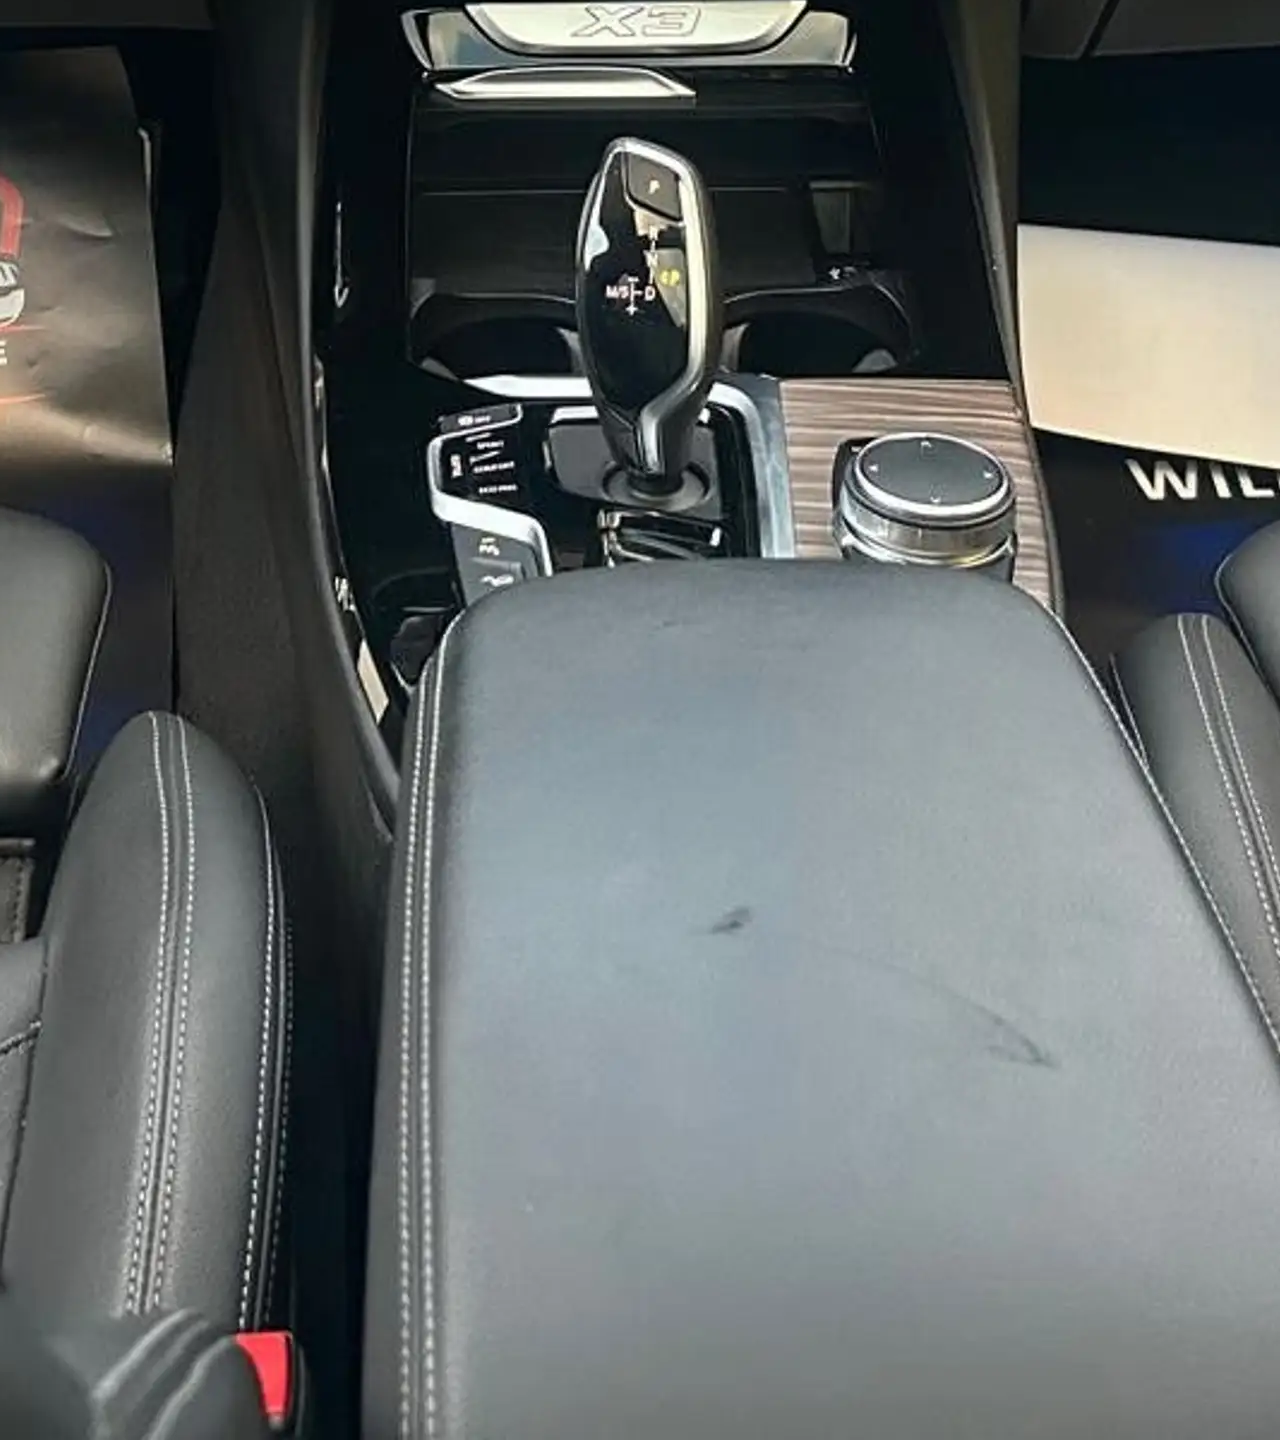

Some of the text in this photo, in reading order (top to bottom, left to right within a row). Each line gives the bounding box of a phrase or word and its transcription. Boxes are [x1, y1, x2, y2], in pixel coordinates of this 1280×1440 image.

[570, 5, 702, 37] X3
[649, 179, 661, 195] P
[644, 286, 656, 301] D
